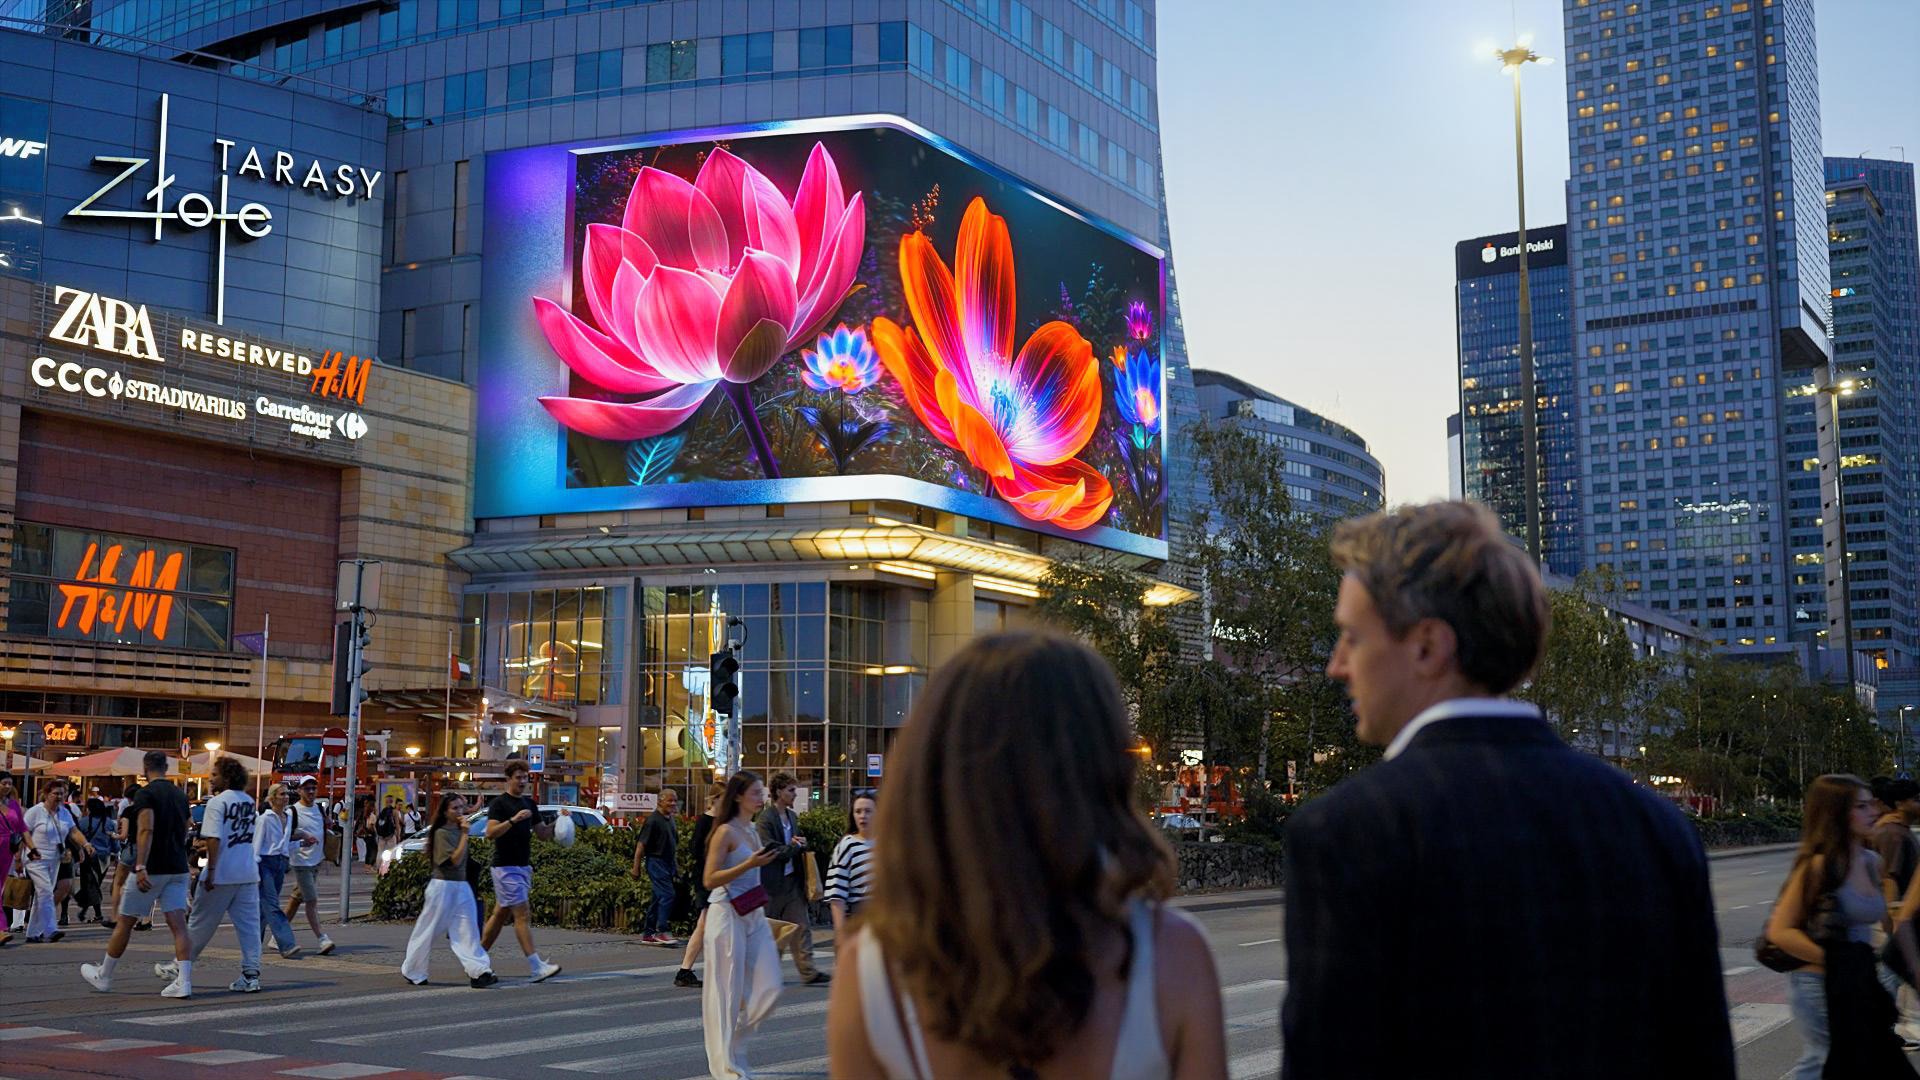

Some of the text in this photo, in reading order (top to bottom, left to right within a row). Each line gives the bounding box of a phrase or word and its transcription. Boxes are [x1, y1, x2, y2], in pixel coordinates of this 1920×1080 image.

[216, 138, 382, 199] TARASY
[1526, 239, 1554, 253] Polski
[49, 285, 165, 362] ZARA
[181, 328, 312, 375] RESERVED
[31, 357, 107, 397] CCC
[310, 350, 372, 406] H&M
[125, 379, 246, 420] STRADIVARIUS
[255, 396, 334, 428] Carrefour
[290, 422, 332, 440] market
[57, 542, 183, 640] H&M
[620, 794, 650, 802] COSTA
